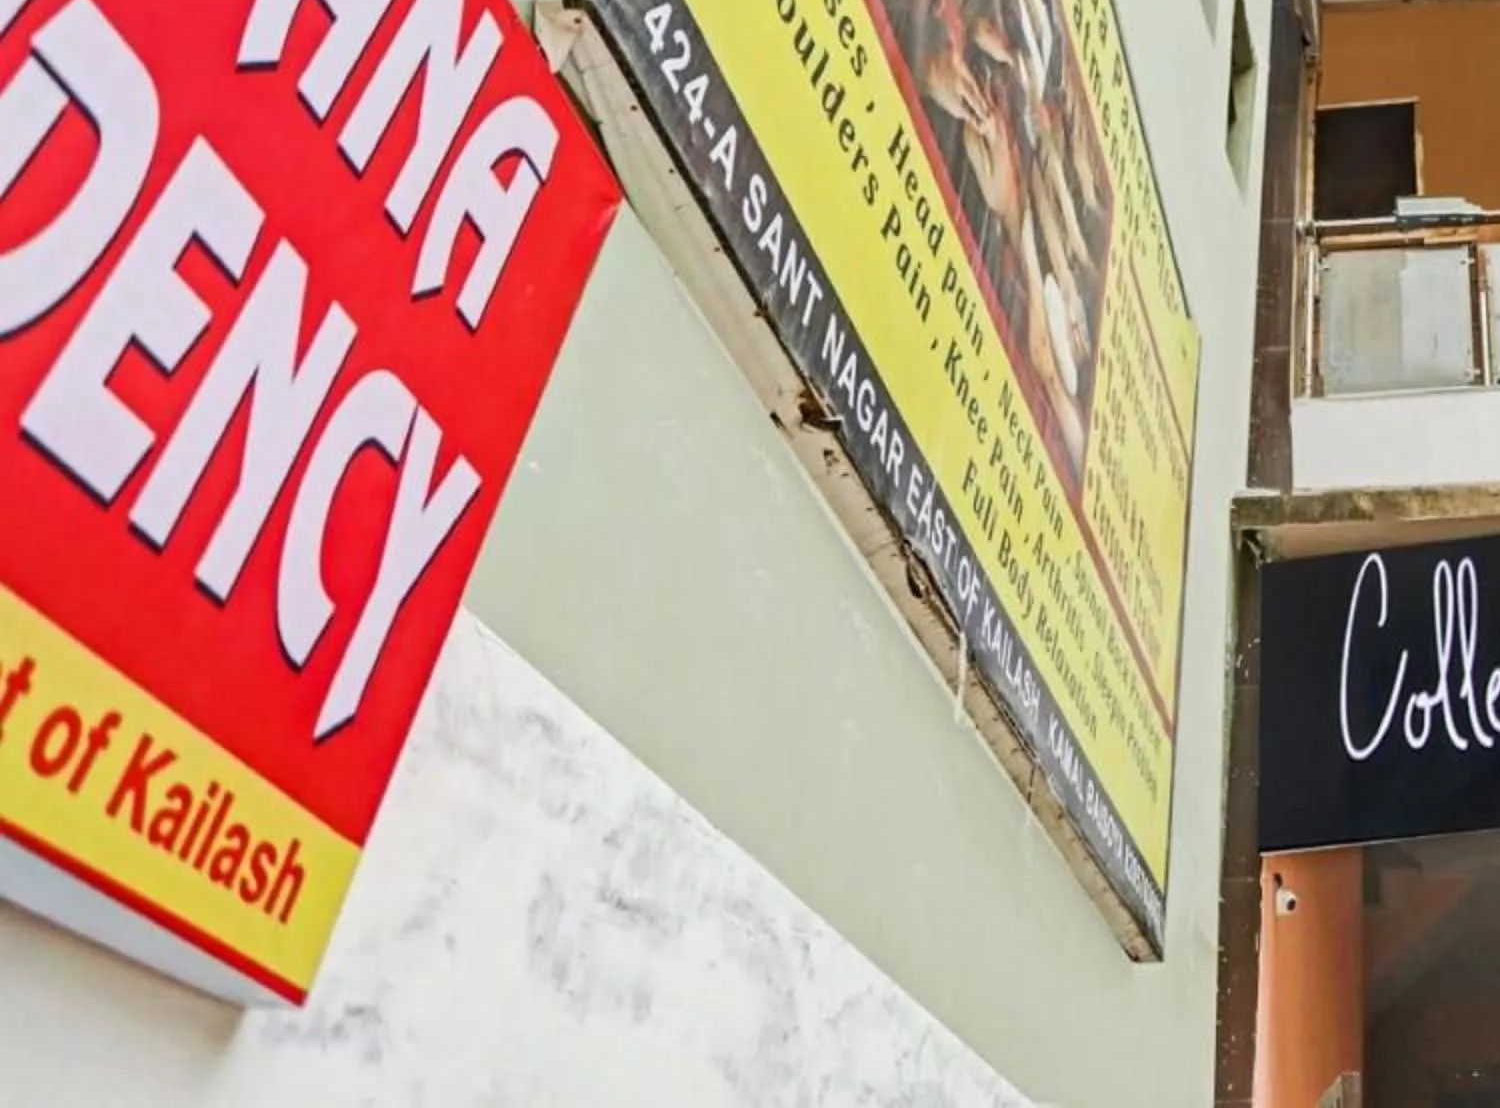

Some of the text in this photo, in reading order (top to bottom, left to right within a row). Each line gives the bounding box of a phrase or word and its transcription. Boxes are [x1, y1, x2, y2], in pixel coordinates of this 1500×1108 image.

[643, 2, 738, 192] 424-A
[742, 173, 823, 327] SANT
[820, 313, 904, 486] NAGAR
[906, 463, 956, 571] EAST
[957, 555, 980, 622] OF
[981, 597, 1041, 725] KAILASH
[880, 203, 930, 322] Pain
[943, 337, 988, 444] Knee
[988, 435, 1024, 525] Pain
[887, 123, 944, 257] Head
[940, 259, 984, 356] pain
[997, 379, 1033, 473] Neck
[961, 458, 997, 541] Full
[997, 527, 1034, 621] Body
[30, 704, 306, 924] of Kailash
